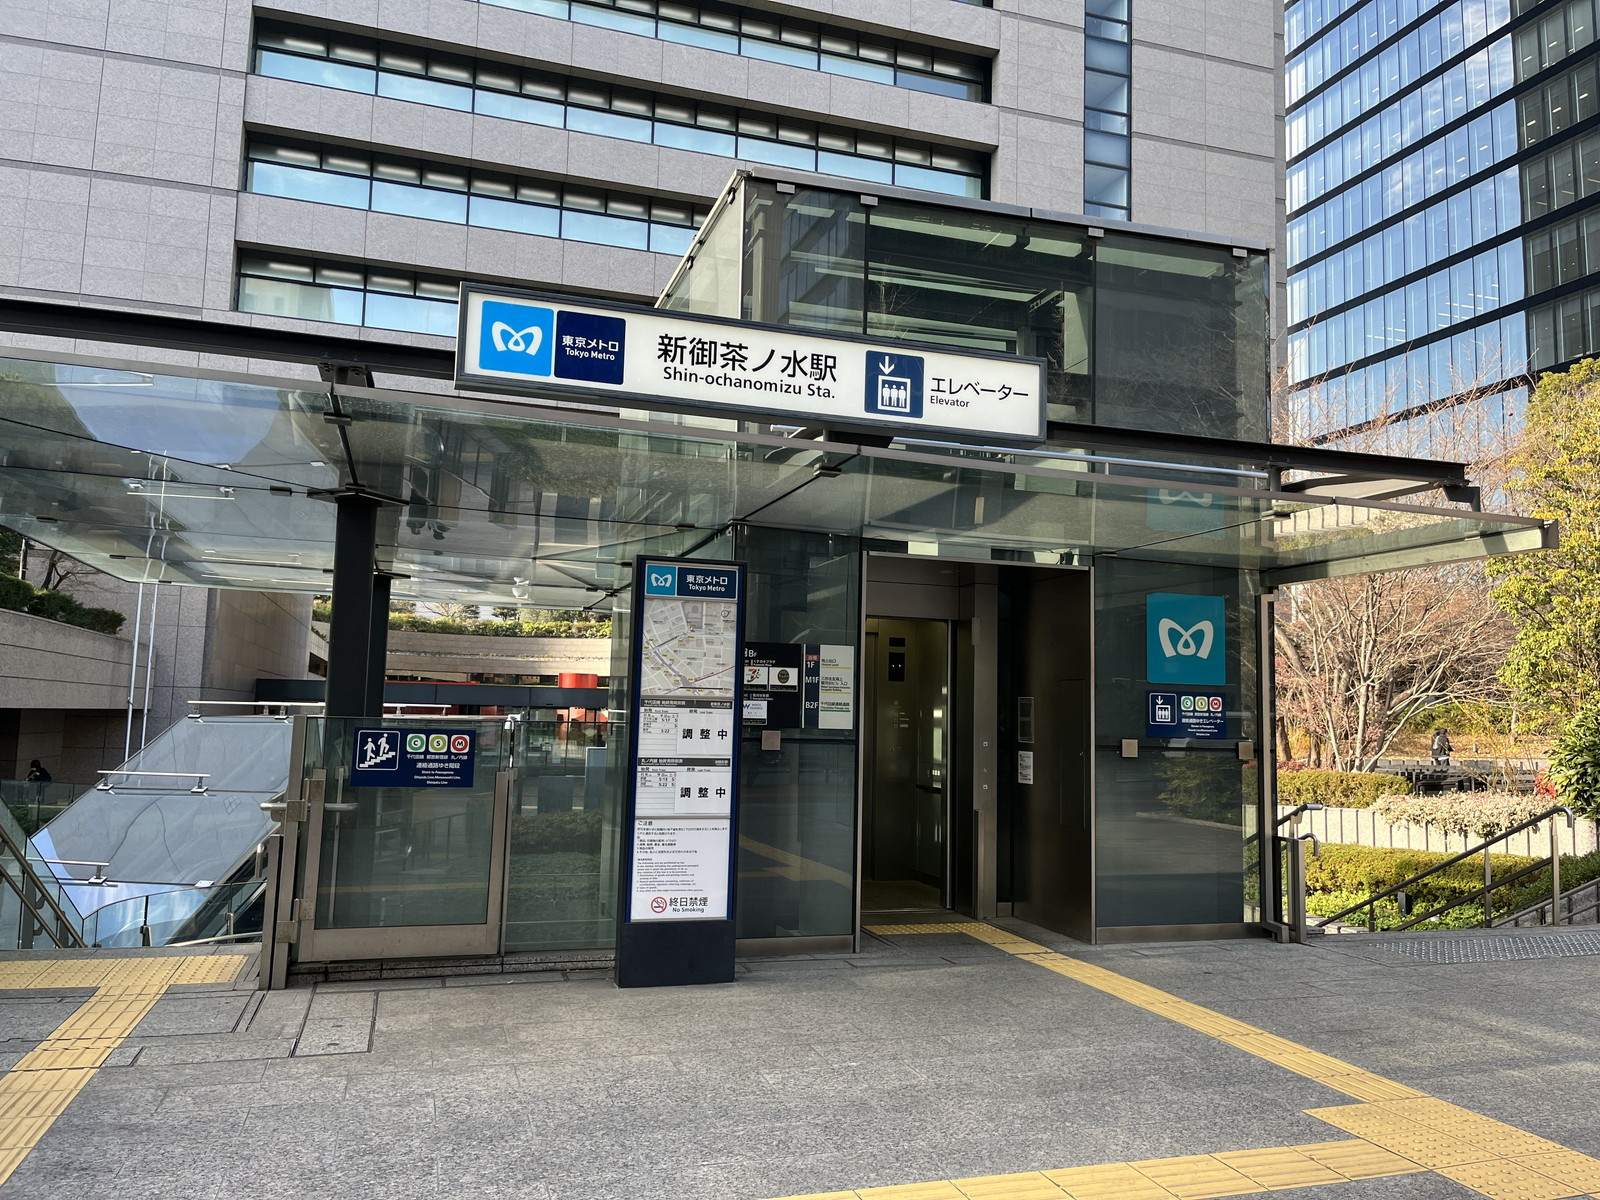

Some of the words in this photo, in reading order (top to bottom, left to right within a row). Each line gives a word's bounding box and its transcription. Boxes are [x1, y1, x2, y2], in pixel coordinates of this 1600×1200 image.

[562, 335, 619, 352] 東京メトロ
[565, 347, 589, 359] Tokyo
[591, 350, 615, 361] Metro
[657, 333, 837, 383] 新御茶ノ水駅
[663, 366, 802, 396] Shin-ochanomizu
[807, 385, 835, 400] Sta.
[931, 377, 1029, 401] エレベーター
[930, 395, 970, 408] Elevator
[686, 574, 728, 585] 東京メトロ
[688, 584, 707, 592] Tokyo
[707, 585, 726, 593] Metro
[807, 661, 815, 669] 1F
[805, 676, 819, 684] M1F
[805, 701, 819, 710] B2F
[682, 728, 728, 740] 調整中
[680, 786, 726, 798] 調整中
[668, 896, 709, 907] 終日禁煙
